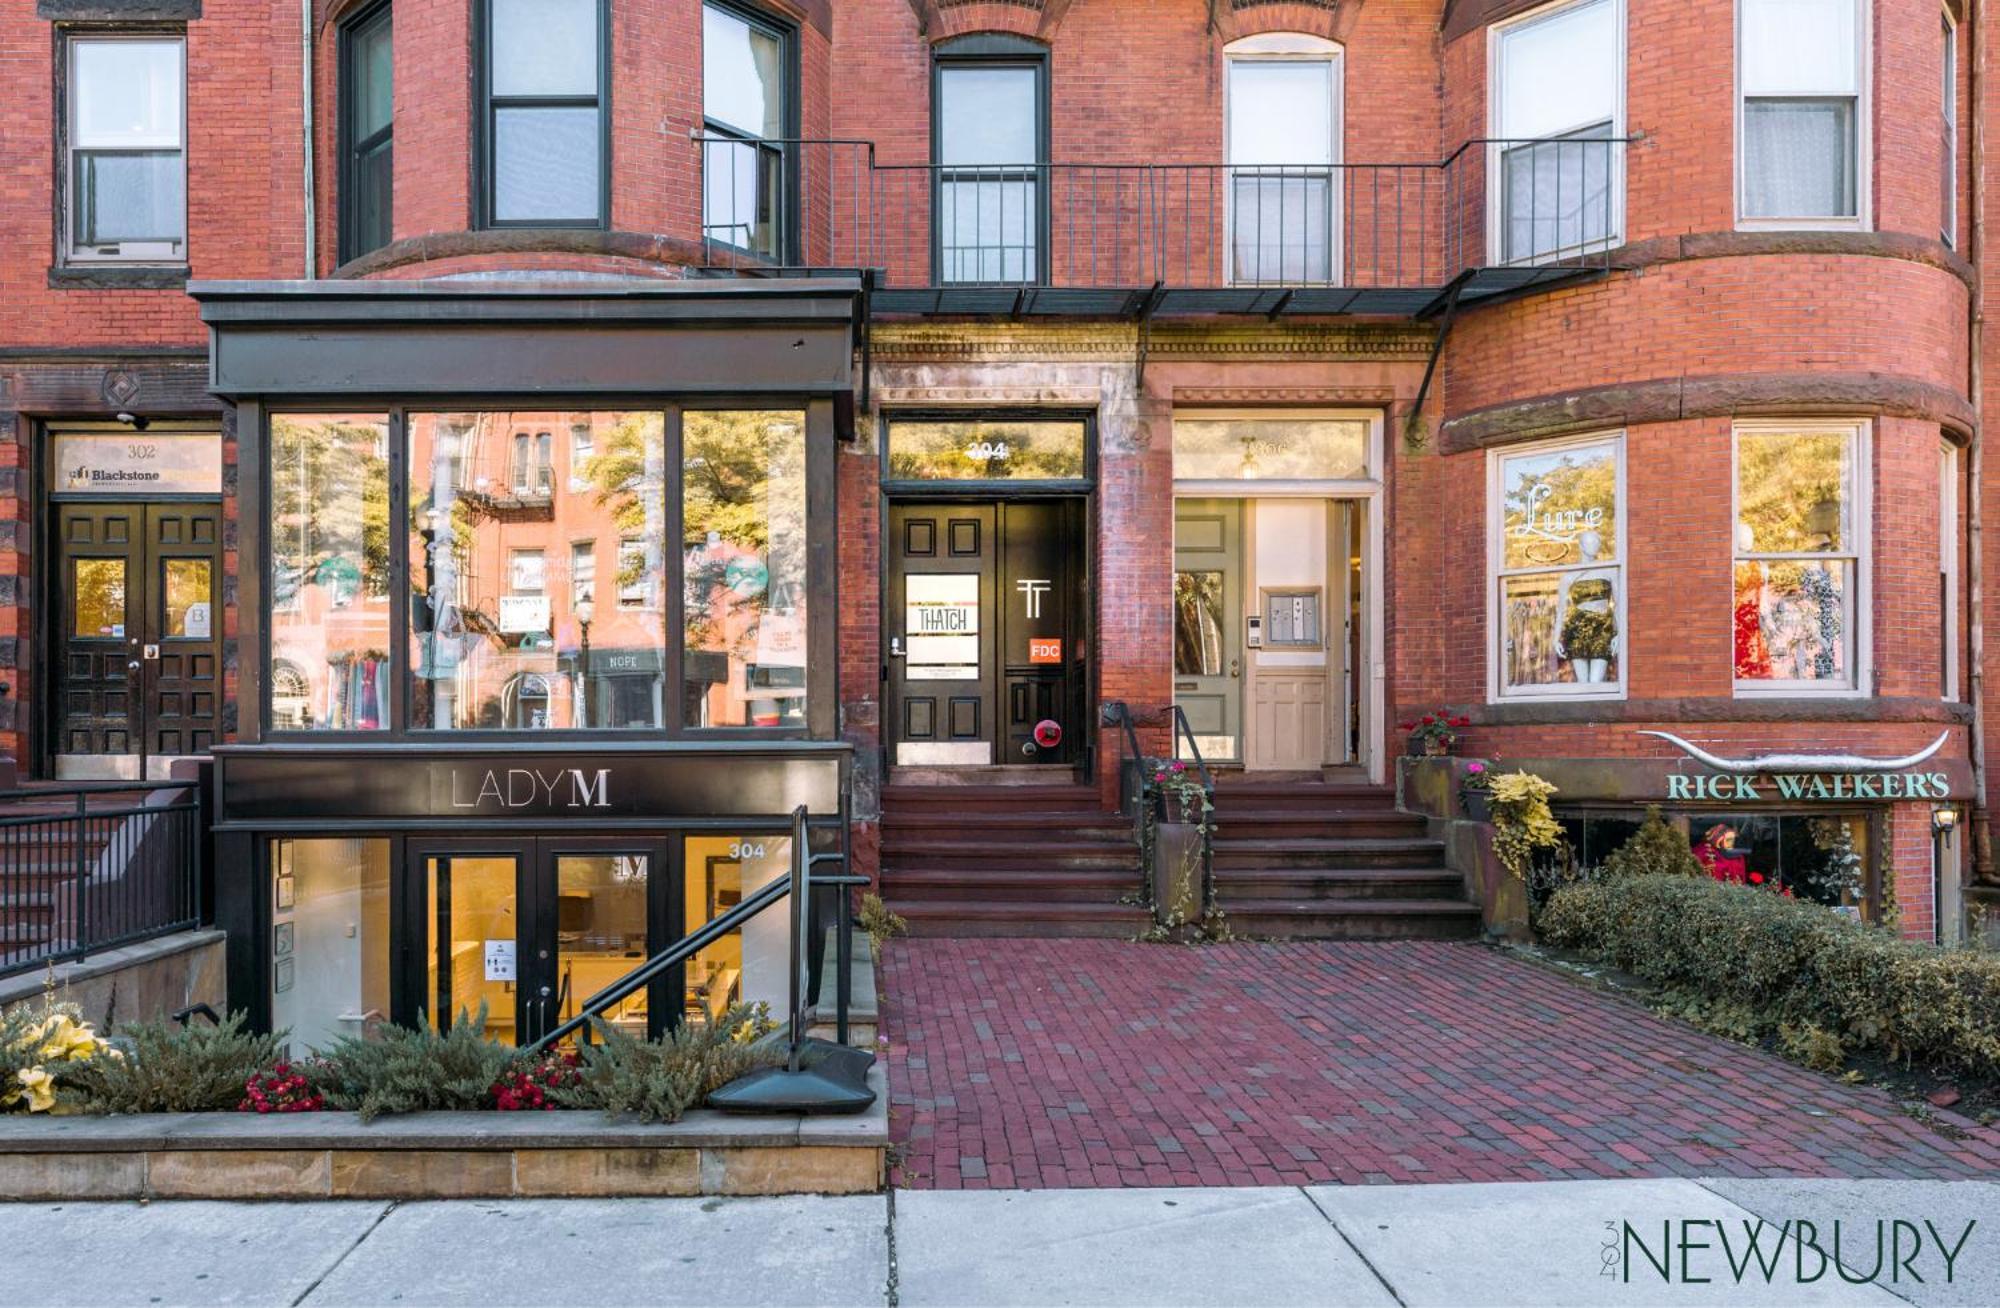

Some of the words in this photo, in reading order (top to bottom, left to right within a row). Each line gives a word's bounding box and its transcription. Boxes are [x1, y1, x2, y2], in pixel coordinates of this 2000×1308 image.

[127, 444, 156, 459] 302
[91, 470, 160, 481] Blackstone
[1515, 483, 1603, 542] Lure
[918, 608, 967, 630] THATCH
[1031, 645, 1059, 657] FDC
[1666, 774, 1761, 799] RICK
[1772, 773, 1950, 799] WALKER'S
[728, 843, 765, 859] 304
